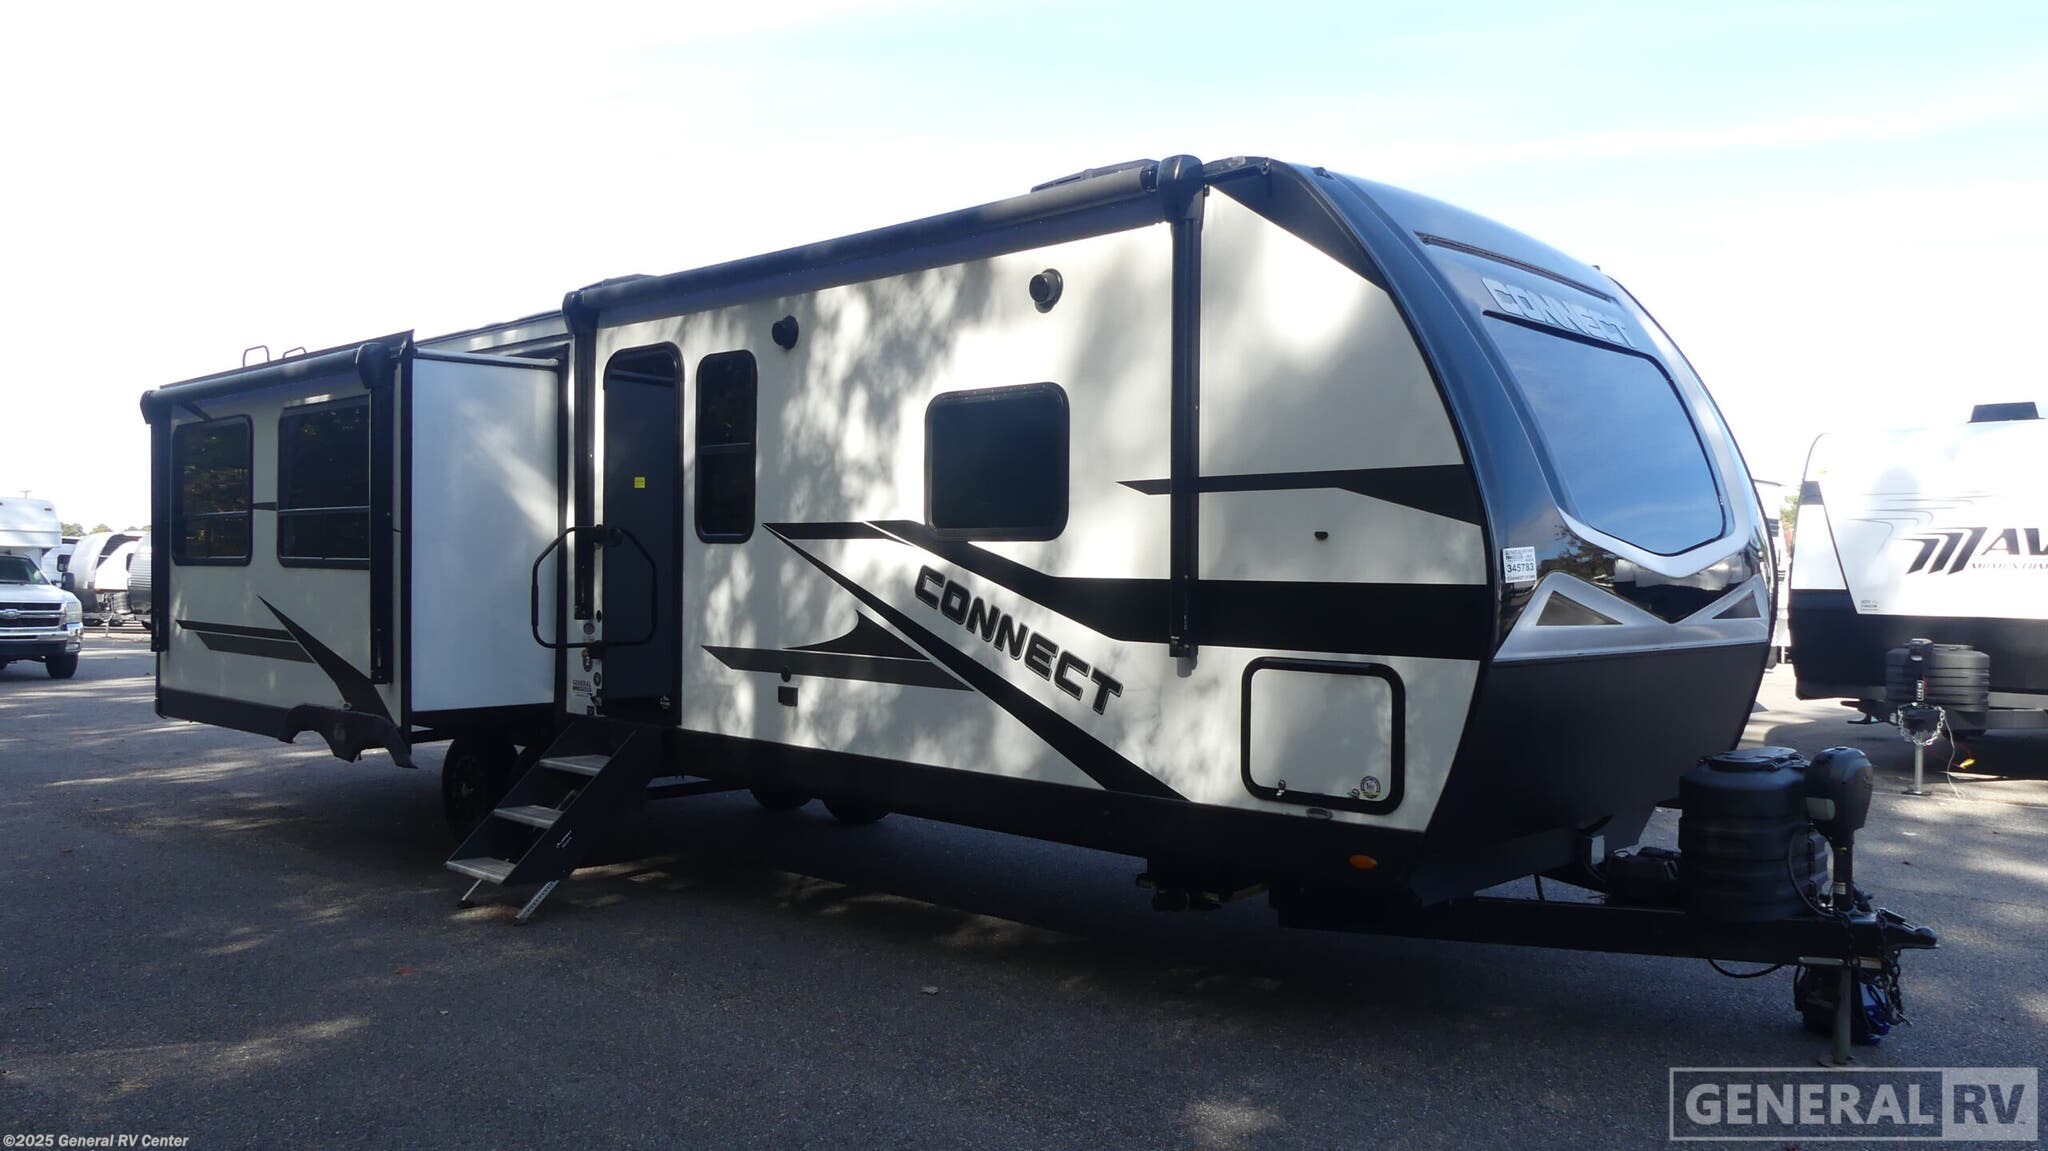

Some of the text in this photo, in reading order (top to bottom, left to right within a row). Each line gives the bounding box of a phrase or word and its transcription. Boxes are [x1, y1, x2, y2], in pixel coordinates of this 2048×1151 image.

[1482, 278, 1635, 348] CONNECT
[1506, 563, 1534, 573] 345783
[915, 565, 1123, 715] CONNECT
